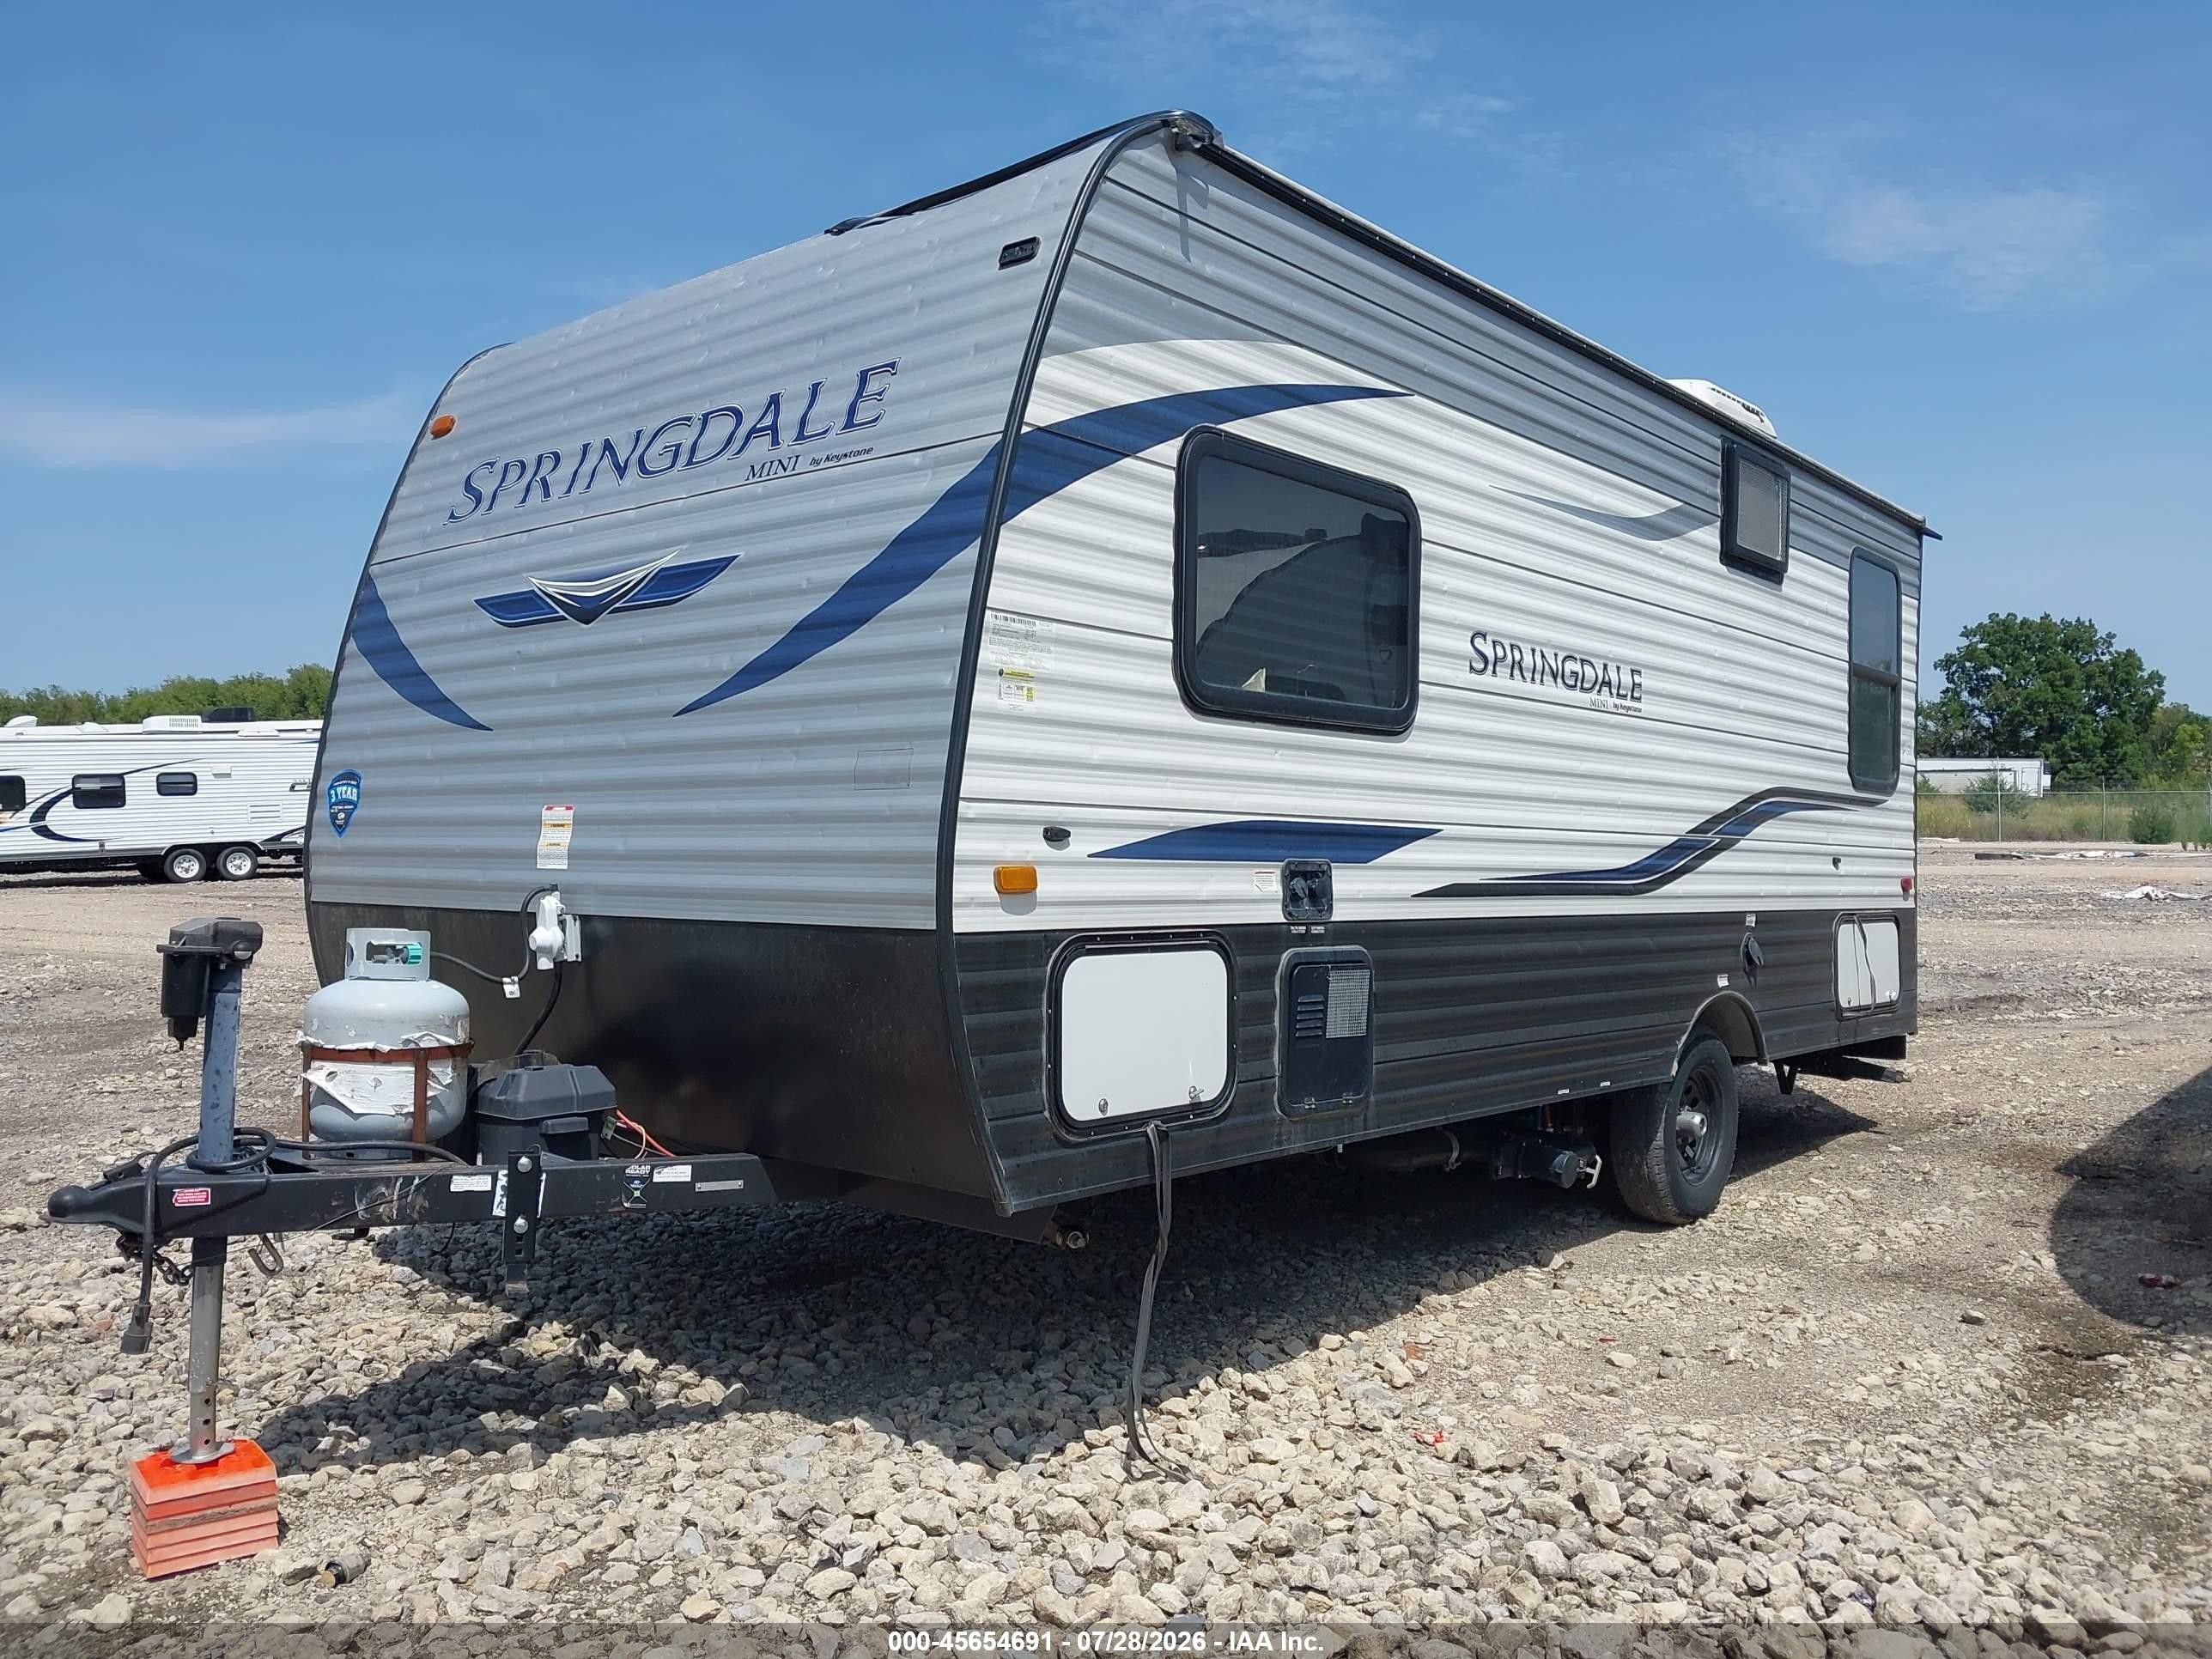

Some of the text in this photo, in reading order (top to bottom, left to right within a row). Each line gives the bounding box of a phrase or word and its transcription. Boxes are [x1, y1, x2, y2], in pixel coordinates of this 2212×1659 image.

[443, 356, 902, 526] SPRINGDALE
[744, 447, 874, 481] MINI by Keystone
[1469, 631, 1642, 703] SPRINGDALE
[1589, 696, 1608, 709] MINI
[1613, 701, 1620, 711] by
[330, 785, 358, 803] 3 YEAR
